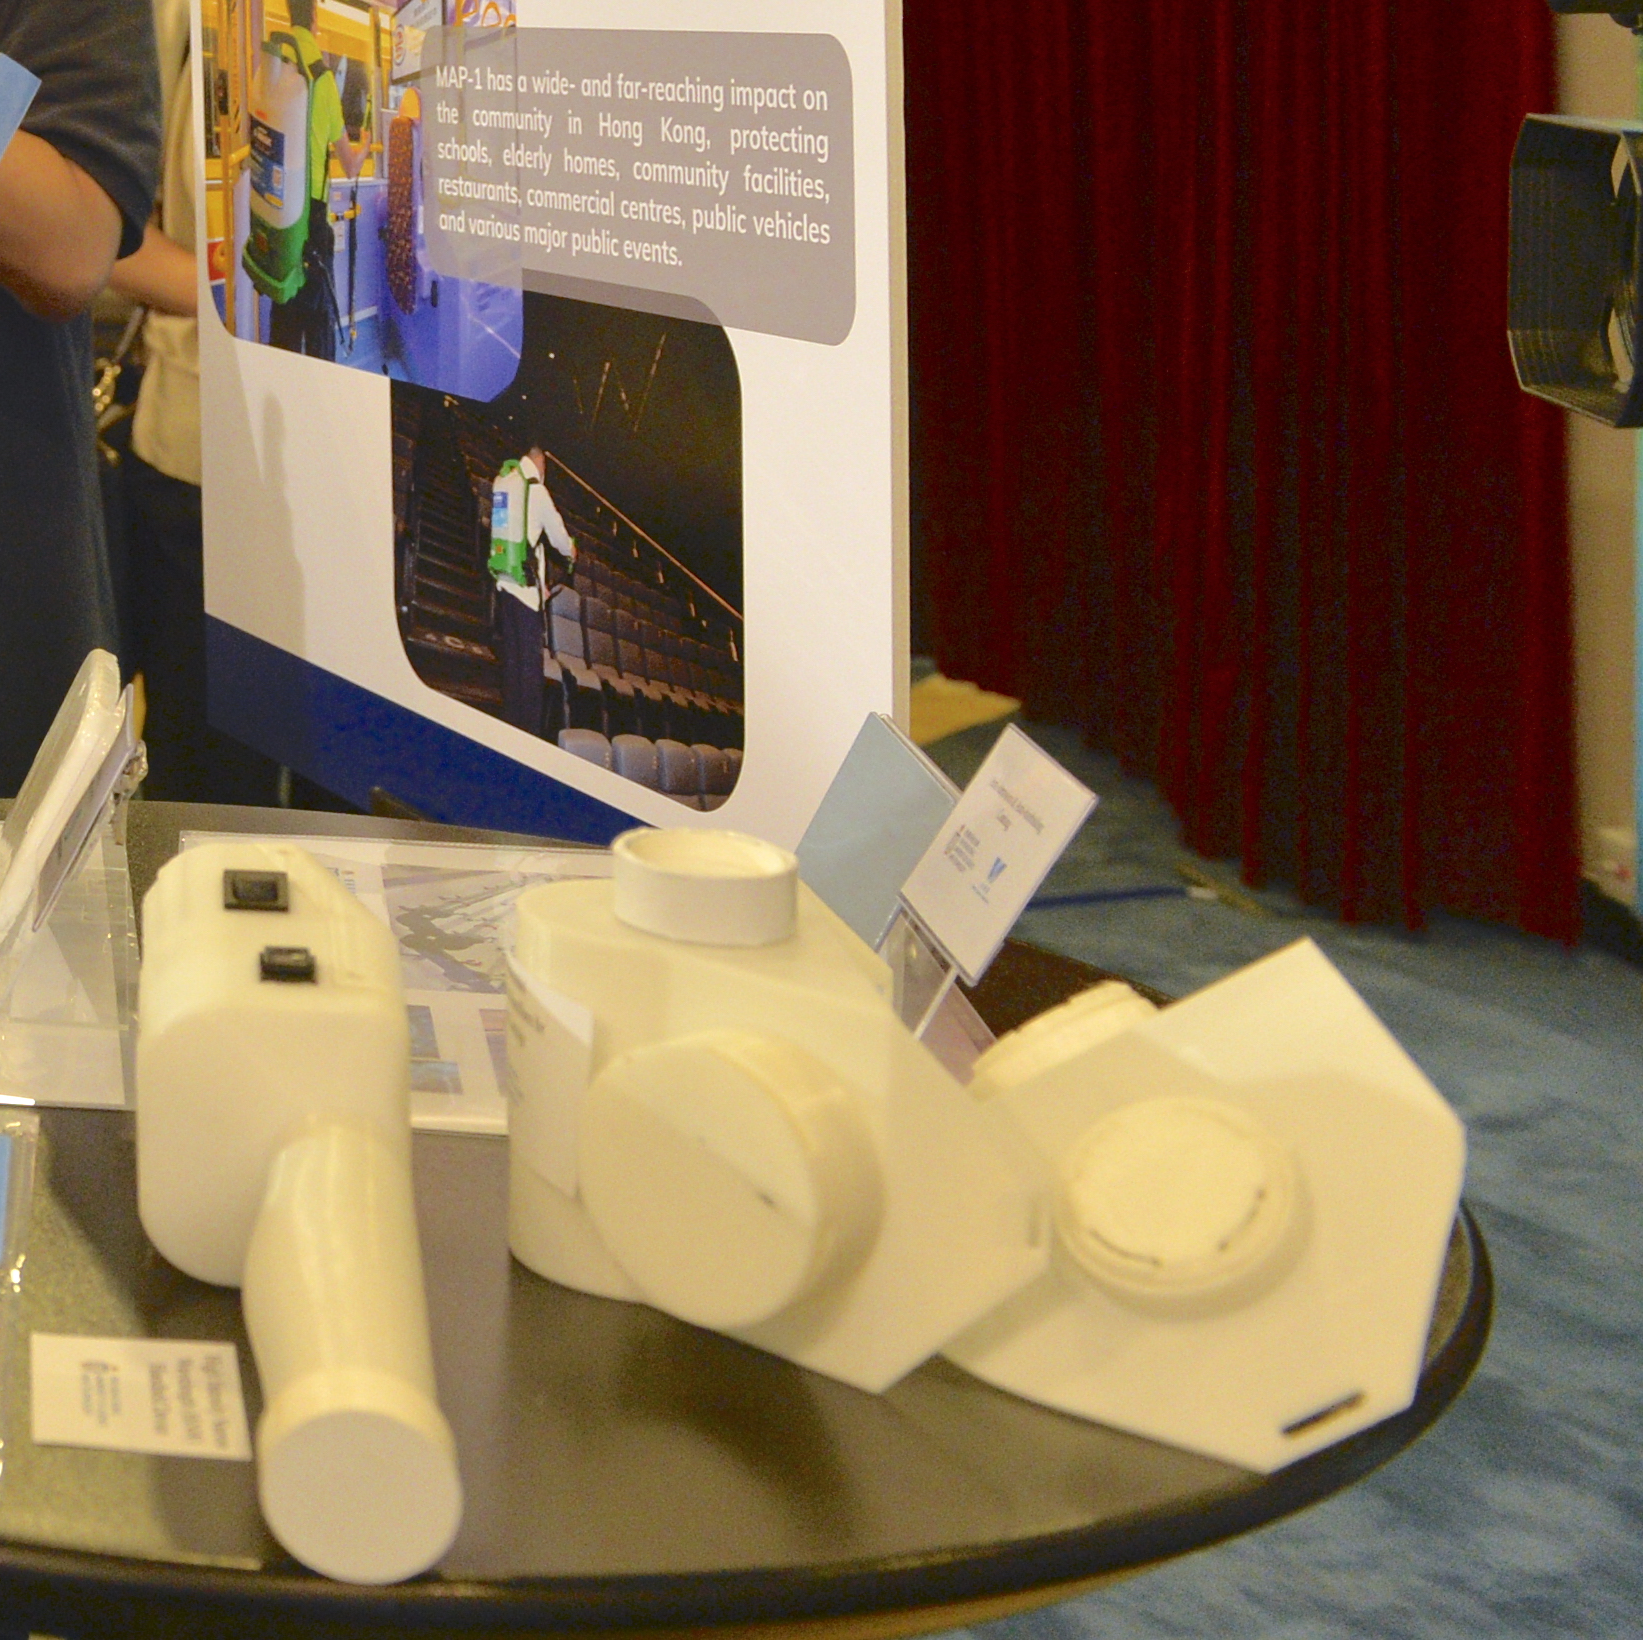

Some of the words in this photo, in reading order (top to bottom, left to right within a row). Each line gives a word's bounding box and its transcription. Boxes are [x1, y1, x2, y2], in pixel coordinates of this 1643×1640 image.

[435, 65, 483, 90] MAP-1
[486, 66, 513, 93] has
[518, 75, 527, 93] a
[532, 69, 576, 96] wide-
[581, 72, 612, 98] and
[617, 73, 724, 112] far-reaching
[730, 78, 797, 115] impact
[803, 88, 828, 111] on
[436, 100, 459, 125] the
[472, 106, 553, 138] community
[568, 109, 583, 135] in
[598, 111, 644, 147] Hong
[661, 116, 711, 153] Kong,
[730, 125, 829, 163] protecting
[437, 137, 492, 167] schools,
[502, 142, 552, 177] elderly
[564, 147, 621, 181] homes,
[633, 160, 730, 197] community
[743, 164, 830, 204] facilities,
[438, 175, 523, 208] restaurants,
[526, 189, 615, 217] commercial
[620, 198, 686, 230] centres,
[692, 203, 747, 235] public
[752, 210, 831, 245] vehicles
[439, 210, 466, 233] and
[468, 214, 521, 242] various
[524, 222, 568, 253] major
[572, 228, 619, 257] public
[623, 238, 683, 267] events.
